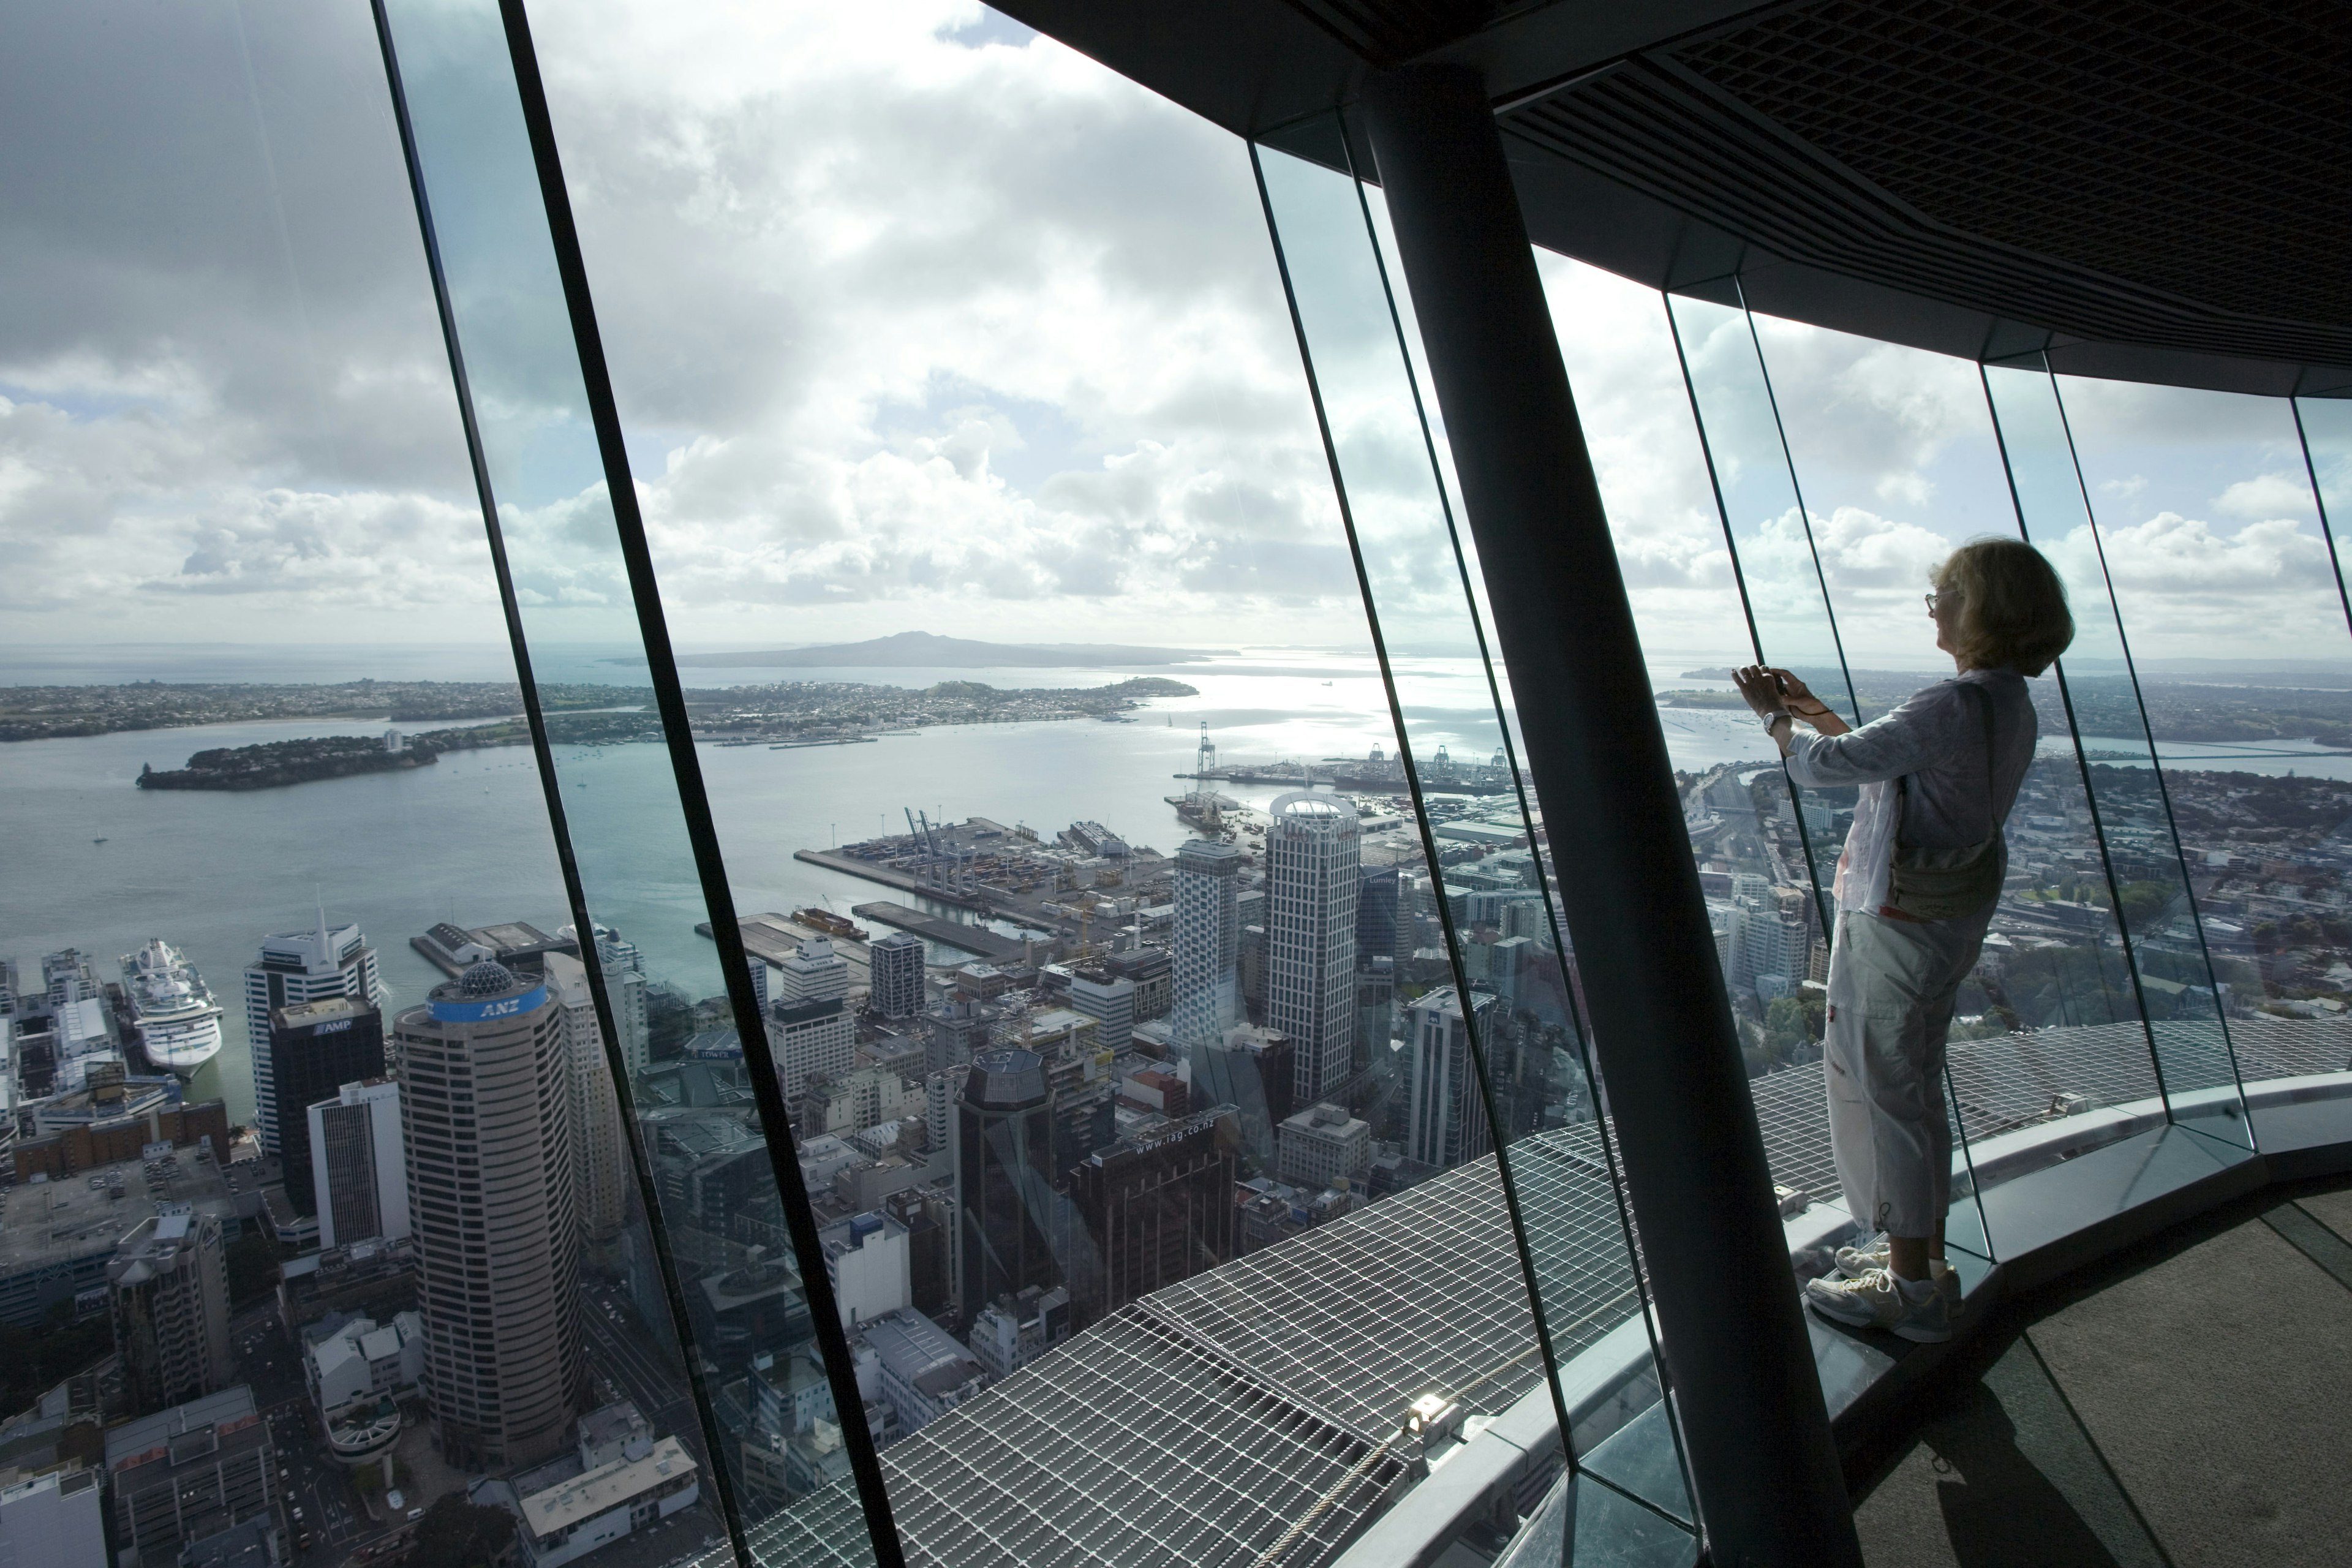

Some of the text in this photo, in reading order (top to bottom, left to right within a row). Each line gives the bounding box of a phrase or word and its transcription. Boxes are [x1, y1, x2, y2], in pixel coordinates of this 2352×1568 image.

[1284, 831, 1309, 843] vero
[480, 999, 519, 1017] ANZ
[325, 1020, 351, 1032] AMP
[1136, 1120, 1214, 1155] www.iag.co.nz
